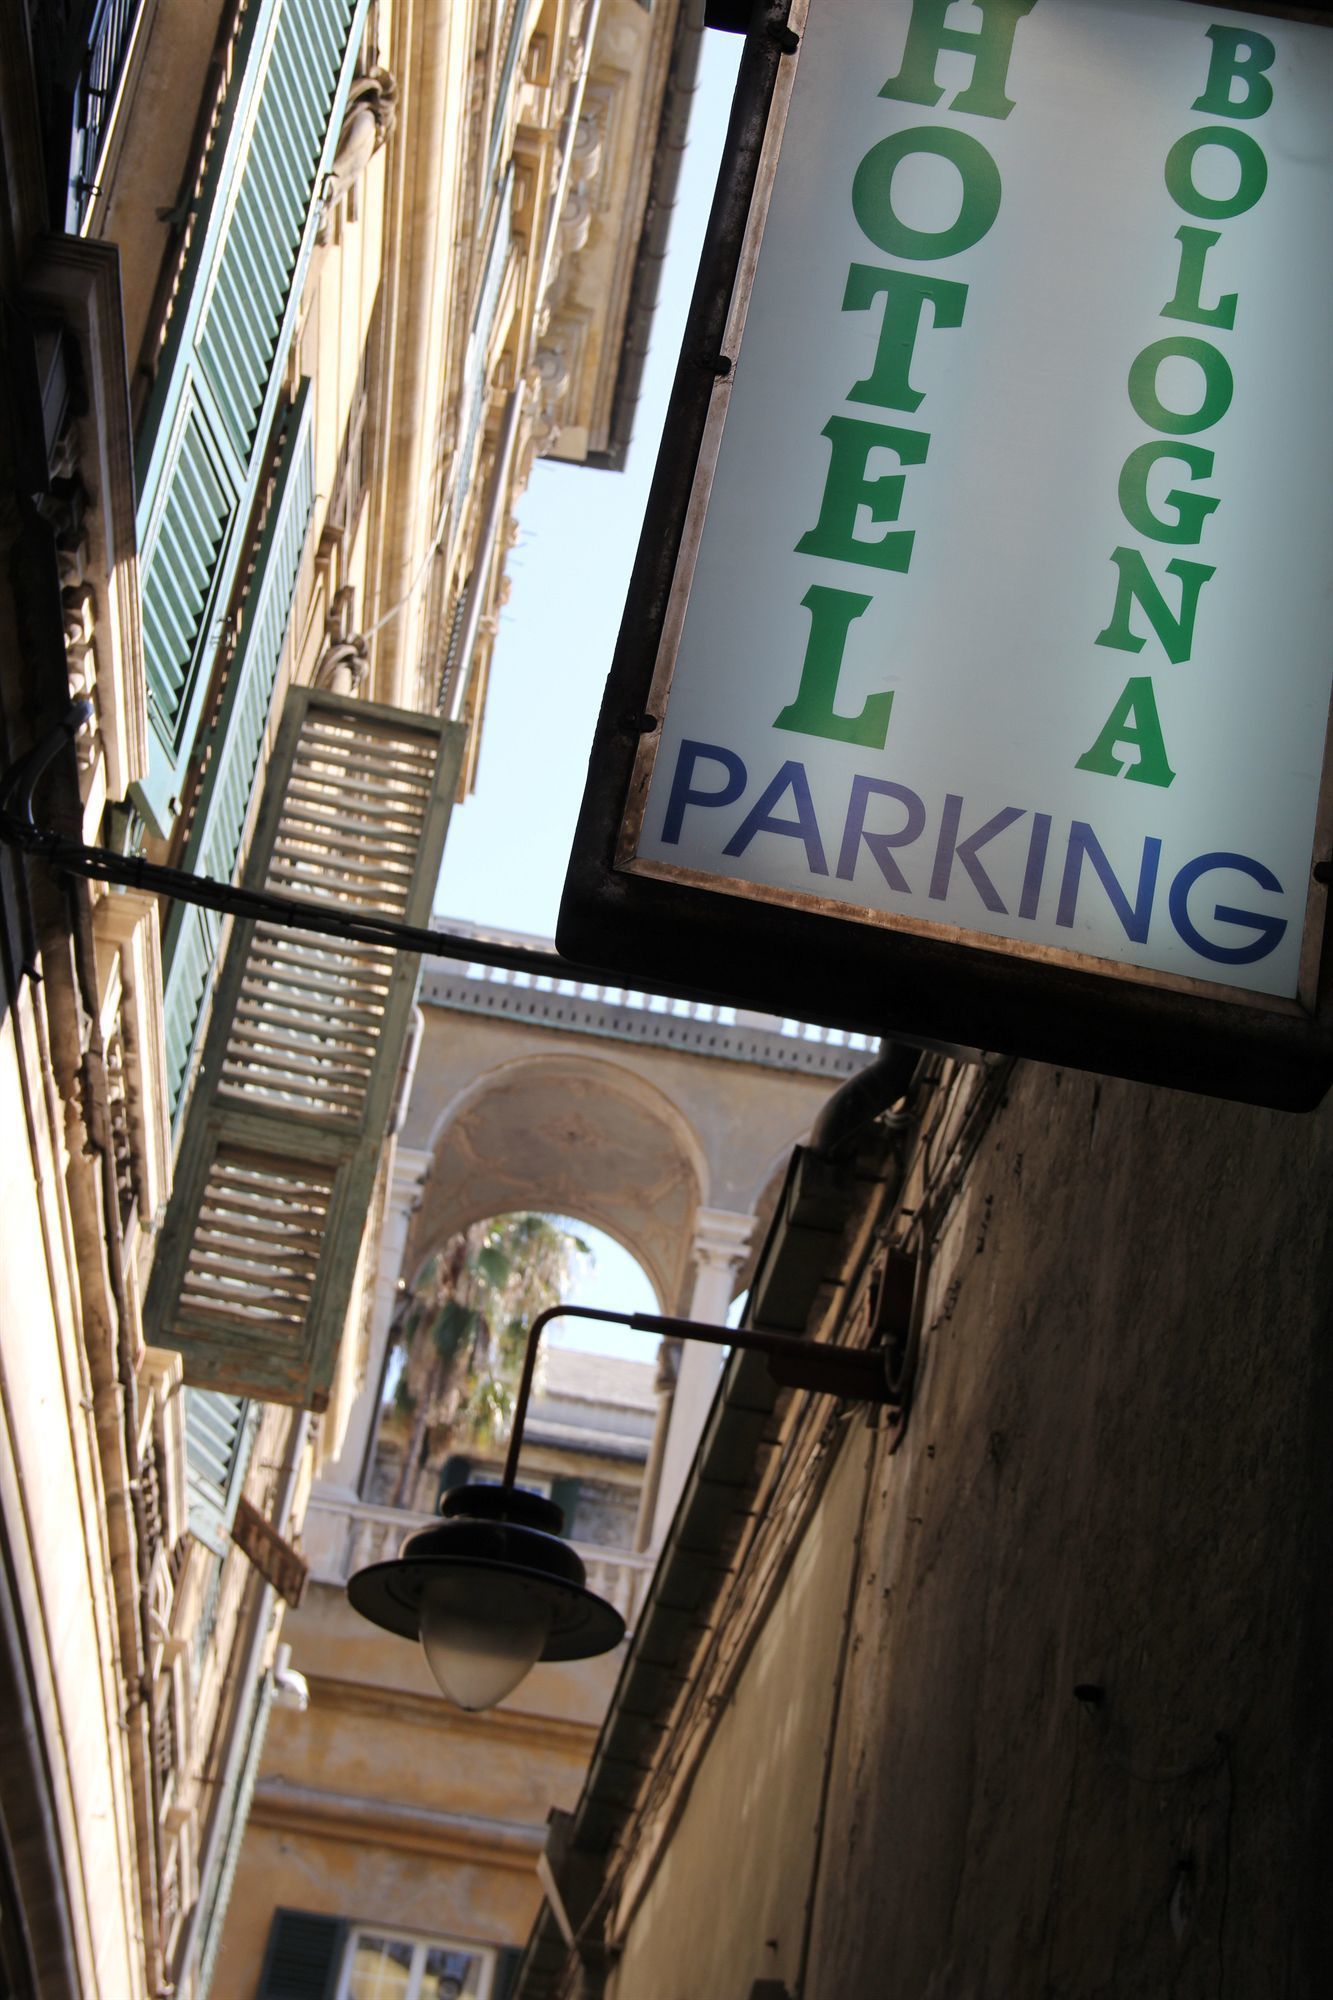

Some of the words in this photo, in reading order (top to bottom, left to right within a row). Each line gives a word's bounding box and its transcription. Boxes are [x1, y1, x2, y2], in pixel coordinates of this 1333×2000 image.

[773, 0, 1038, 750] HOTEL
[1074, 24, 1277, 788] BOLOGNA
[660, 739, 1288, 965] PARKING
